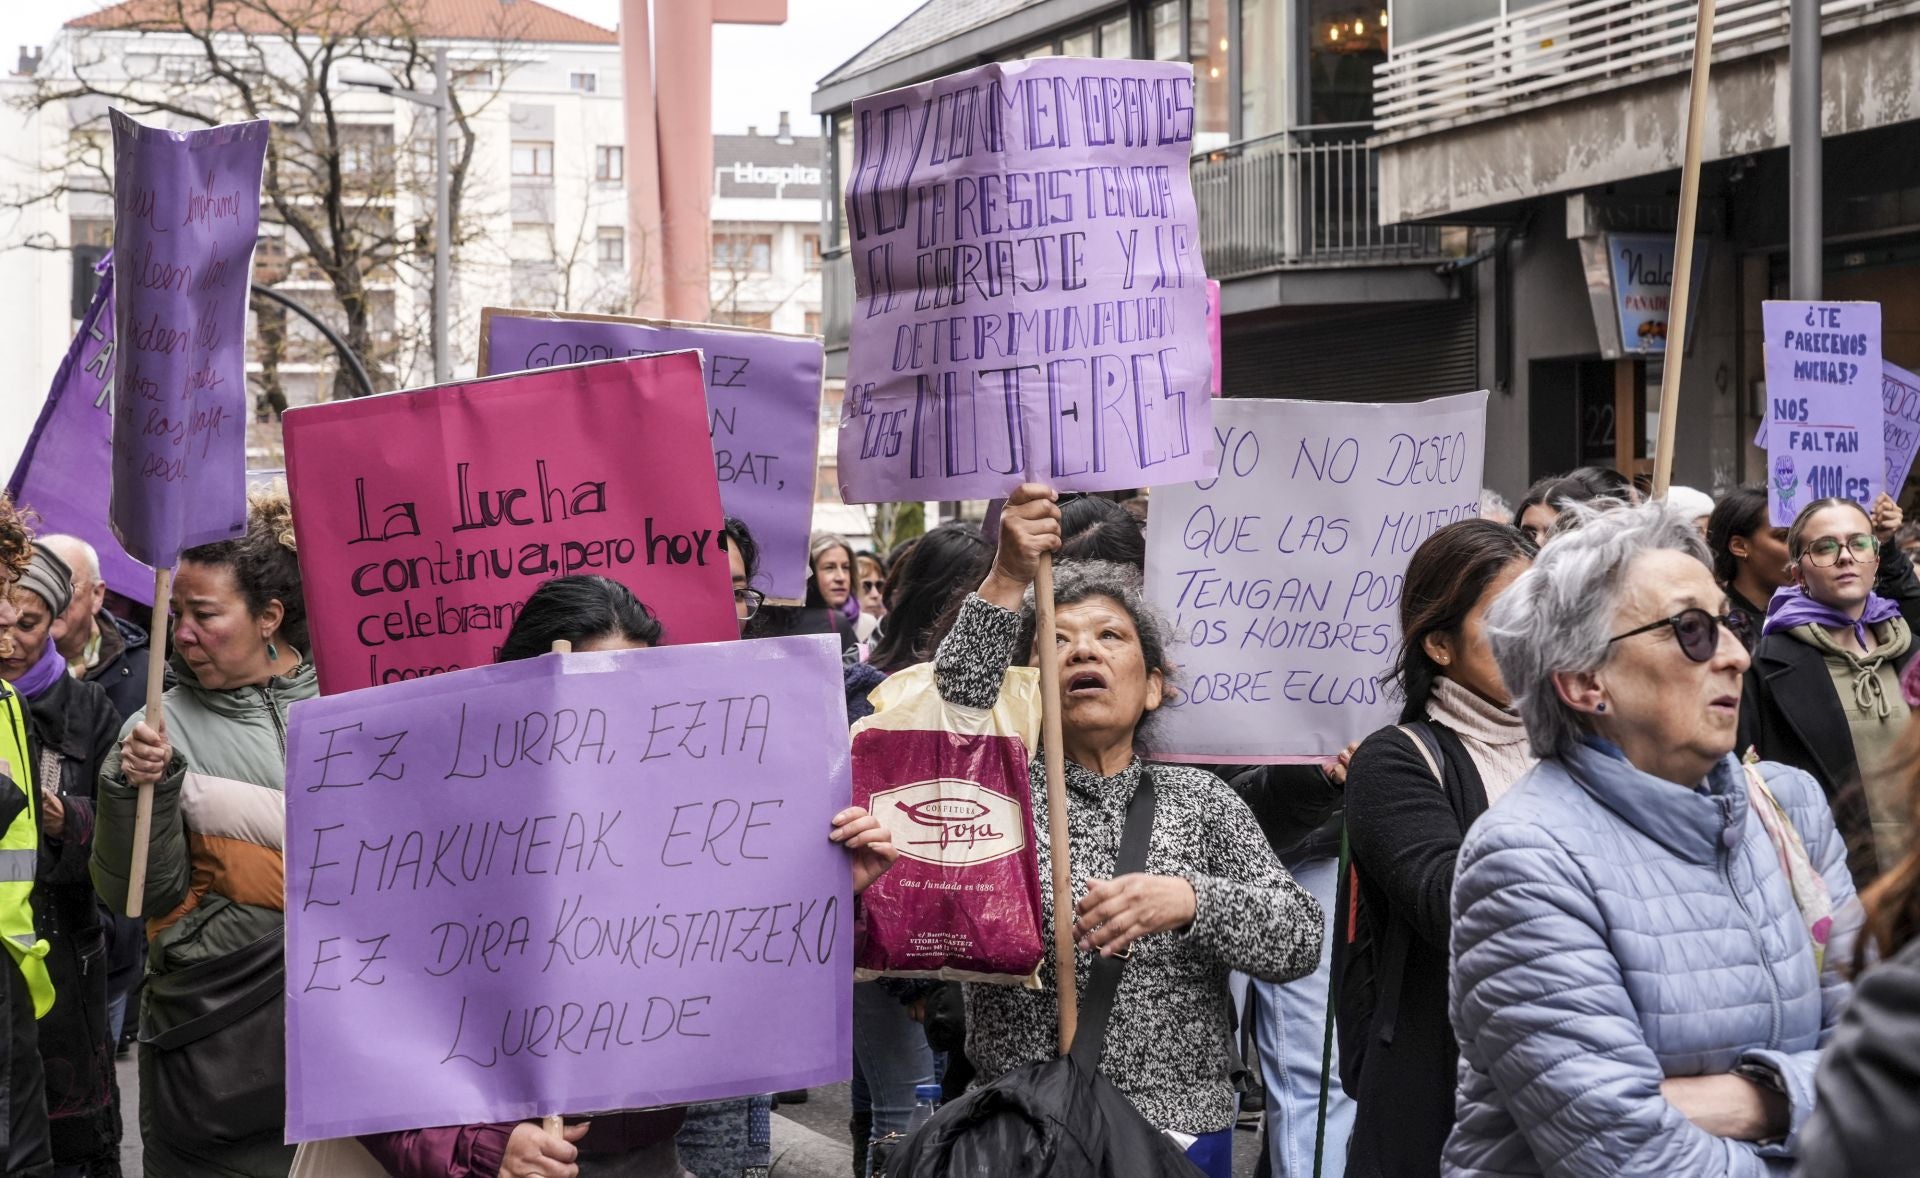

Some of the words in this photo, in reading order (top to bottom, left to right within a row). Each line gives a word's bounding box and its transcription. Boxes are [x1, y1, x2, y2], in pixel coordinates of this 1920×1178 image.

[734, 161, 821, 187] Hospita
[955, 165, 1177, 241] RESISTENCIA
[915, 231, 1088, 311] CORAJE
[1117, 229, 1139, 291] Y
[1784, 330, 1867, 356] PARECEMOS
[1805, 306, 1841, 328] ¿TE
[710, 355, 751, 388] EZ
[1793, 360, 1858, 385] MUCHAS?
[910, 347, 1191, 479] MUJERES
[1774, 399, 1809, 421] NOS
[1194, 426, 1259, 491] YO
[1291, 437, 1359, 484] NO
[1377, 431, 1466, 487] DESEO
[1790, 431, 1859, 453] FALTAN
[347, 477, 421, 546] La
[452, 459, 607, 533] Lucha
[1184, 505, 1261, 558] QUE
[1278, 515, 1349, 554] LAS
[1176, 568, 1332, 613] TENGAN
[1343, 570, 1402, 621] POD
[356, 596, 525, 647] celebram
[1284, 670, 1380, 706] ELLAS
[443, 702, 617, 781] LURRA,
[639, 694, 771, 765] EZTA
[926, 804, 975, 815] CONFITURA
[304, 808, 624, 912] EMAKUMEAK
[660, 798, 785, 868] ERE
[899, 879, 920, 888] Casa
[922, 880, 962, 891] fundada
[304, 933, 391, 994] EZ
[441, 995, 712, 1068] LURRALDE
